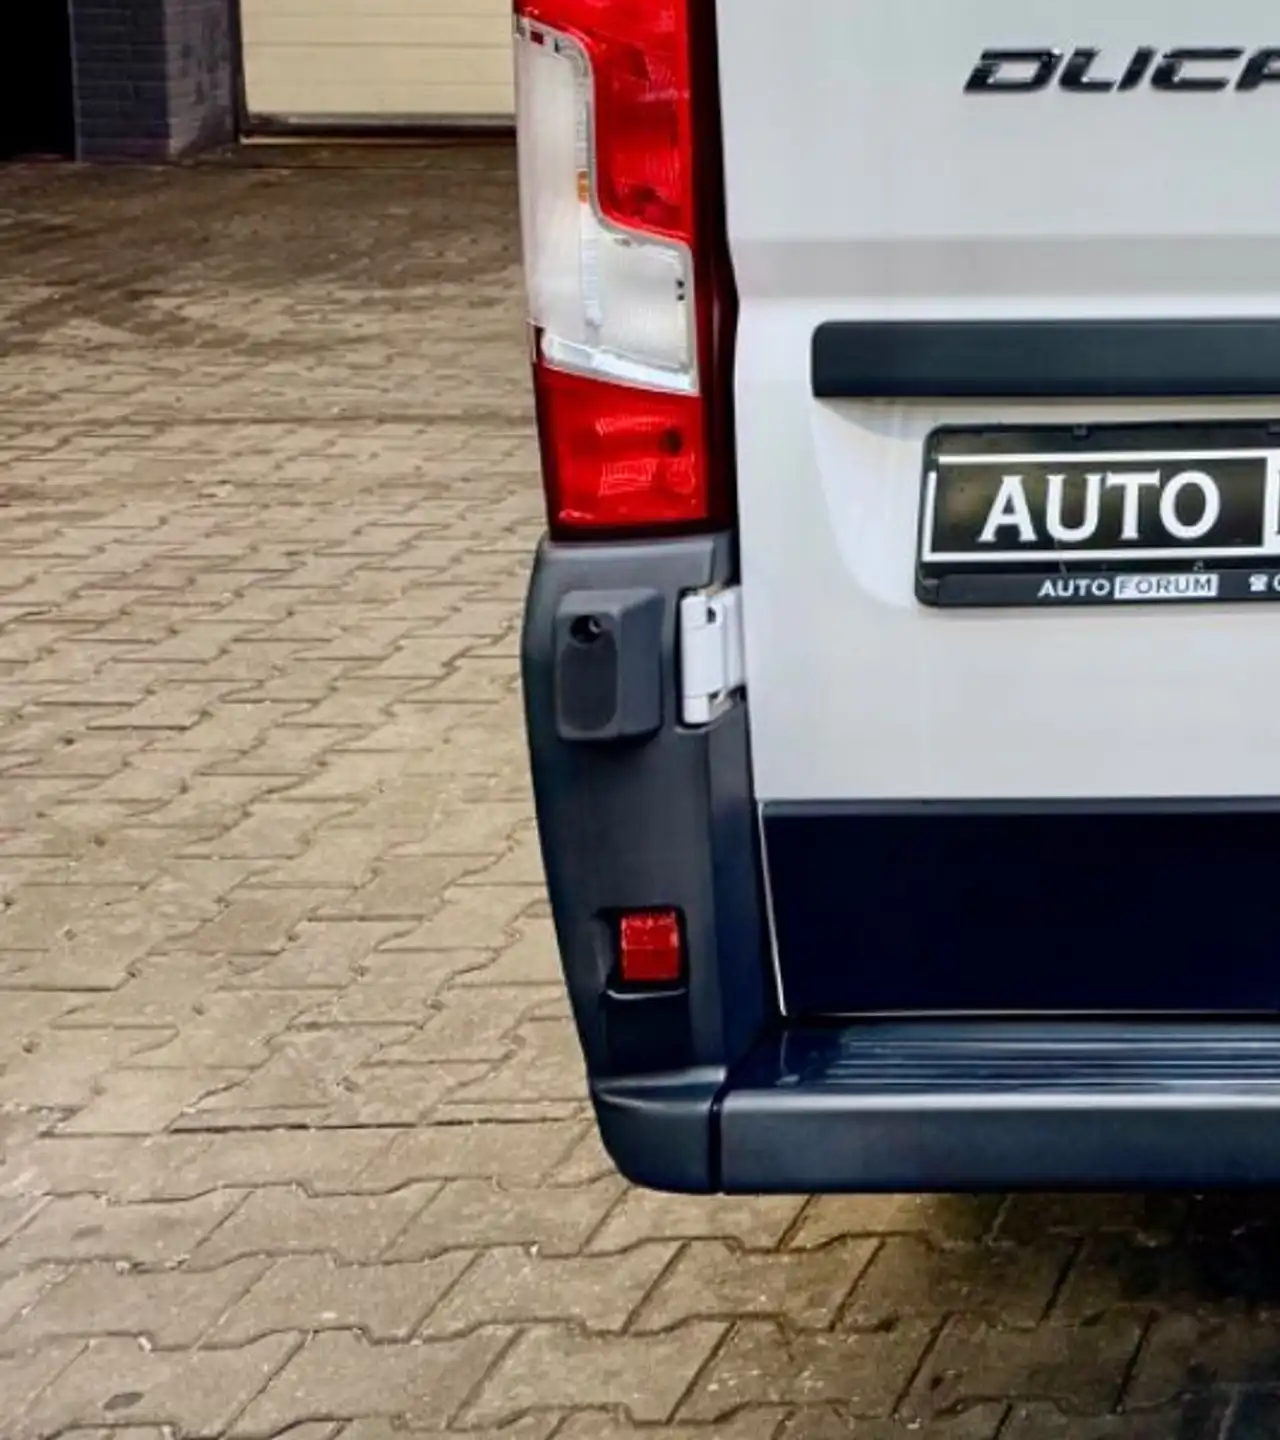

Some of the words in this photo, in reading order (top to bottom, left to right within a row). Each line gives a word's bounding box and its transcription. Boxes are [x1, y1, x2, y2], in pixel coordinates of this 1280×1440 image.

[977, 469, 1222, 543] AUTO
[1037, 578, 1111, 598] AUTO
[1116, 574, 1215, 597] FORUM
